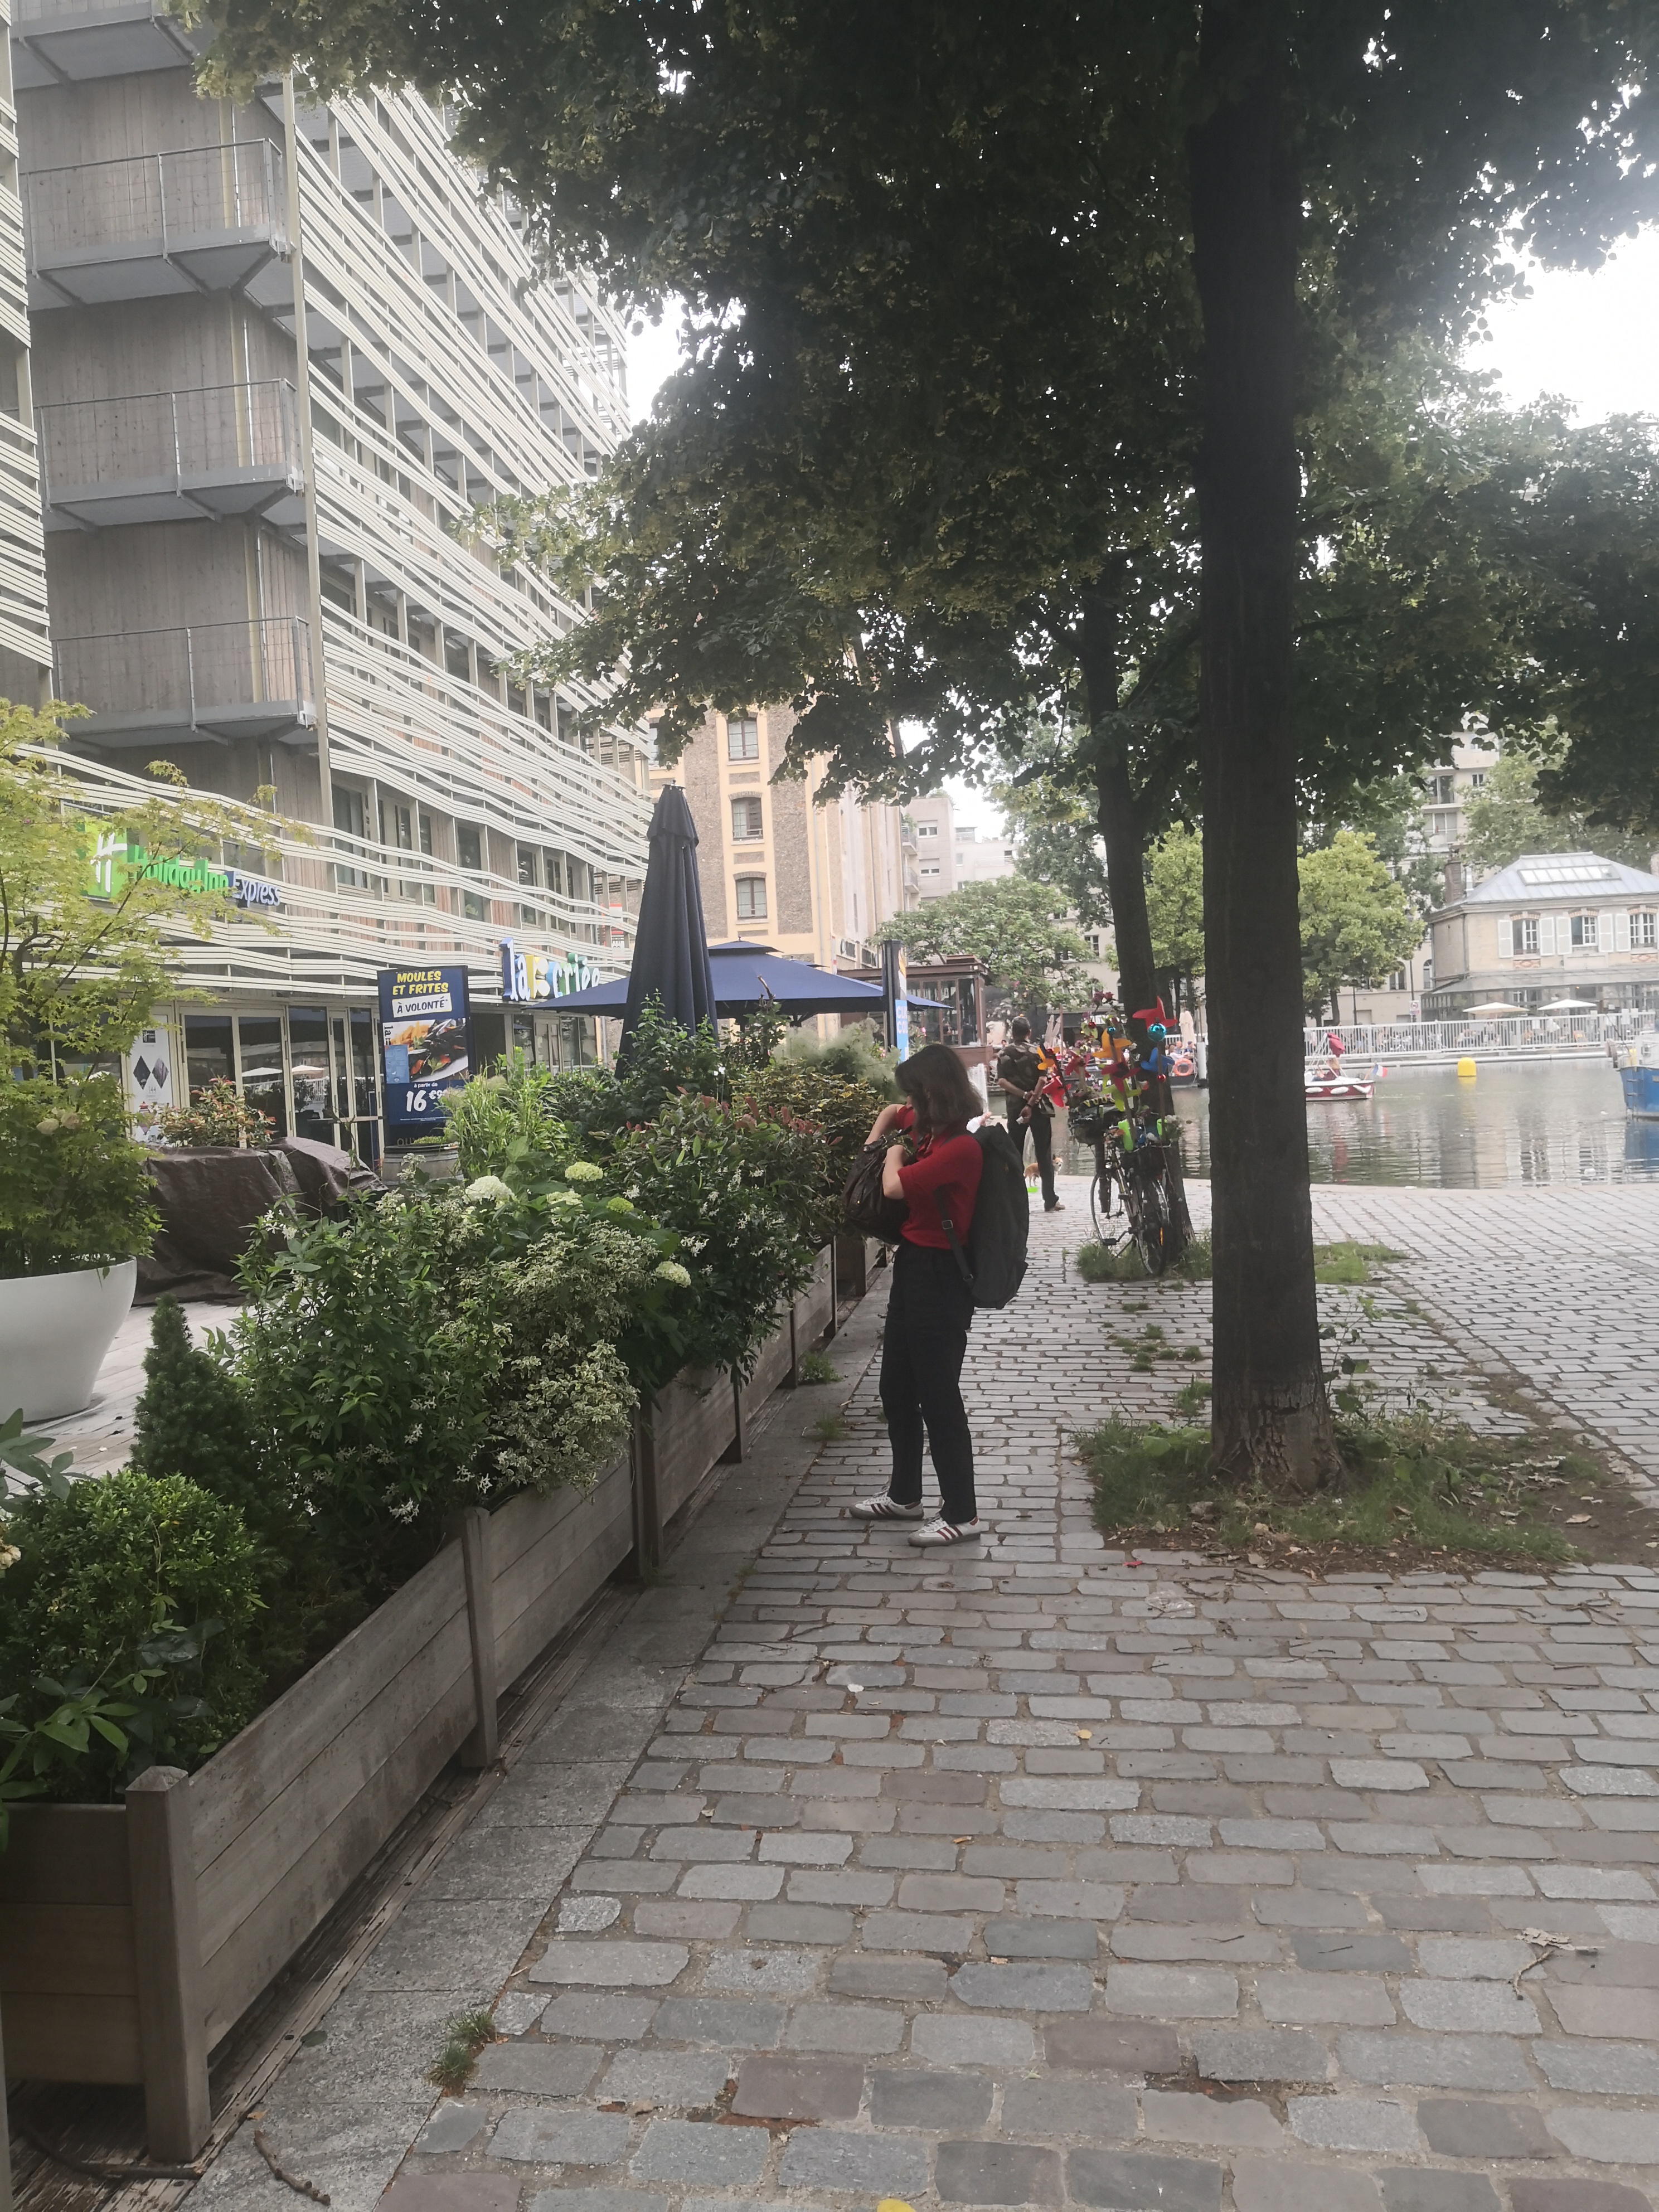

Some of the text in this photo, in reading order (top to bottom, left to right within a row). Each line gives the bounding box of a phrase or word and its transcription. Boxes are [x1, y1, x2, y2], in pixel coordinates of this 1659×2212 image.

[231, 871, 280, 908] Express
[397, 971, 442, 983] MOULES
[392, 982, 449, 995] ET FRITES
[397, 1002, 402, 1013] À
[406, 1090, 426, 1112] 16
